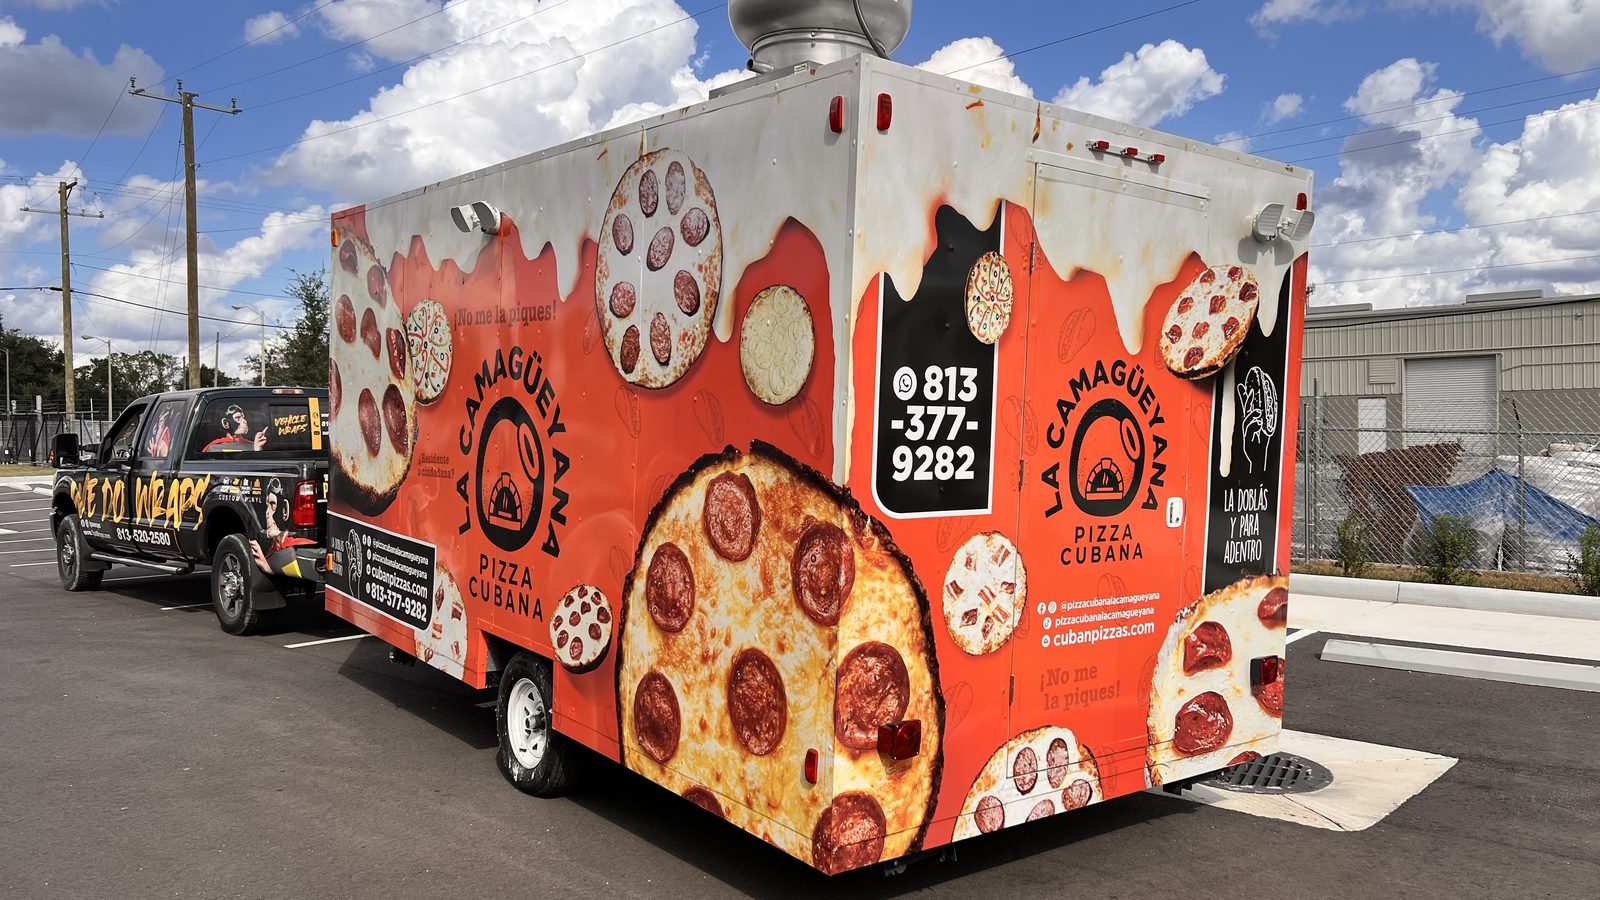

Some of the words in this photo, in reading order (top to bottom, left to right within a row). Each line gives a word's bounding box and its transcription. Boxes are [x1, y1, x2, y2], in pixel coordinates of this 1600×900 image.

[475, 309, 493, 325] me
[495, 304, 506, 323] la
[509, 299, 557, 327] piques!
[923, 365, 979, 402] 813
[274, 414, 307, 427] VEHICLE
[278, 423, 308, 436] WRAPS
[1046, 359, 1168, 512] CAMAGÜEYANA
[460, 346, 570, 558] CAMAGÜEYANA
[892, 445, 976, 482] 9282
[70, 472, 98, 519] WE
[102, 477, 125, 523] DO
[136, 470, 211, 531] WRAPS
[456, 472, 472, 536] LA
[1041, 462, 1063, 518] LA
[1224, 489, 1234, 512] LA
[1238, 484, 1268, 513] DOBLÁS
[1075, 523, 1133, 544] PIZZA
[1230, 517, 1236, 538] Y
[1240, 513, 1259, 537] PARA
[1061, 546, 1143, 566] CUBANA
[1224, 539, 1262, 564] ADENTRO
[371, 566, 428, 599] cubanpizzas.com
[479, 553, 532, 590] PIZZA
[371, 582, 427, 622] 813-377-9282
[469, 577, 543, 622] CUBANA
[1053, 622, 1155, 647] cubanpizzas.com
[1074, 665, 1098, 682] me
[1044, 693, 1060, 711] la
[1064, 680, 1121, 711] piques!
